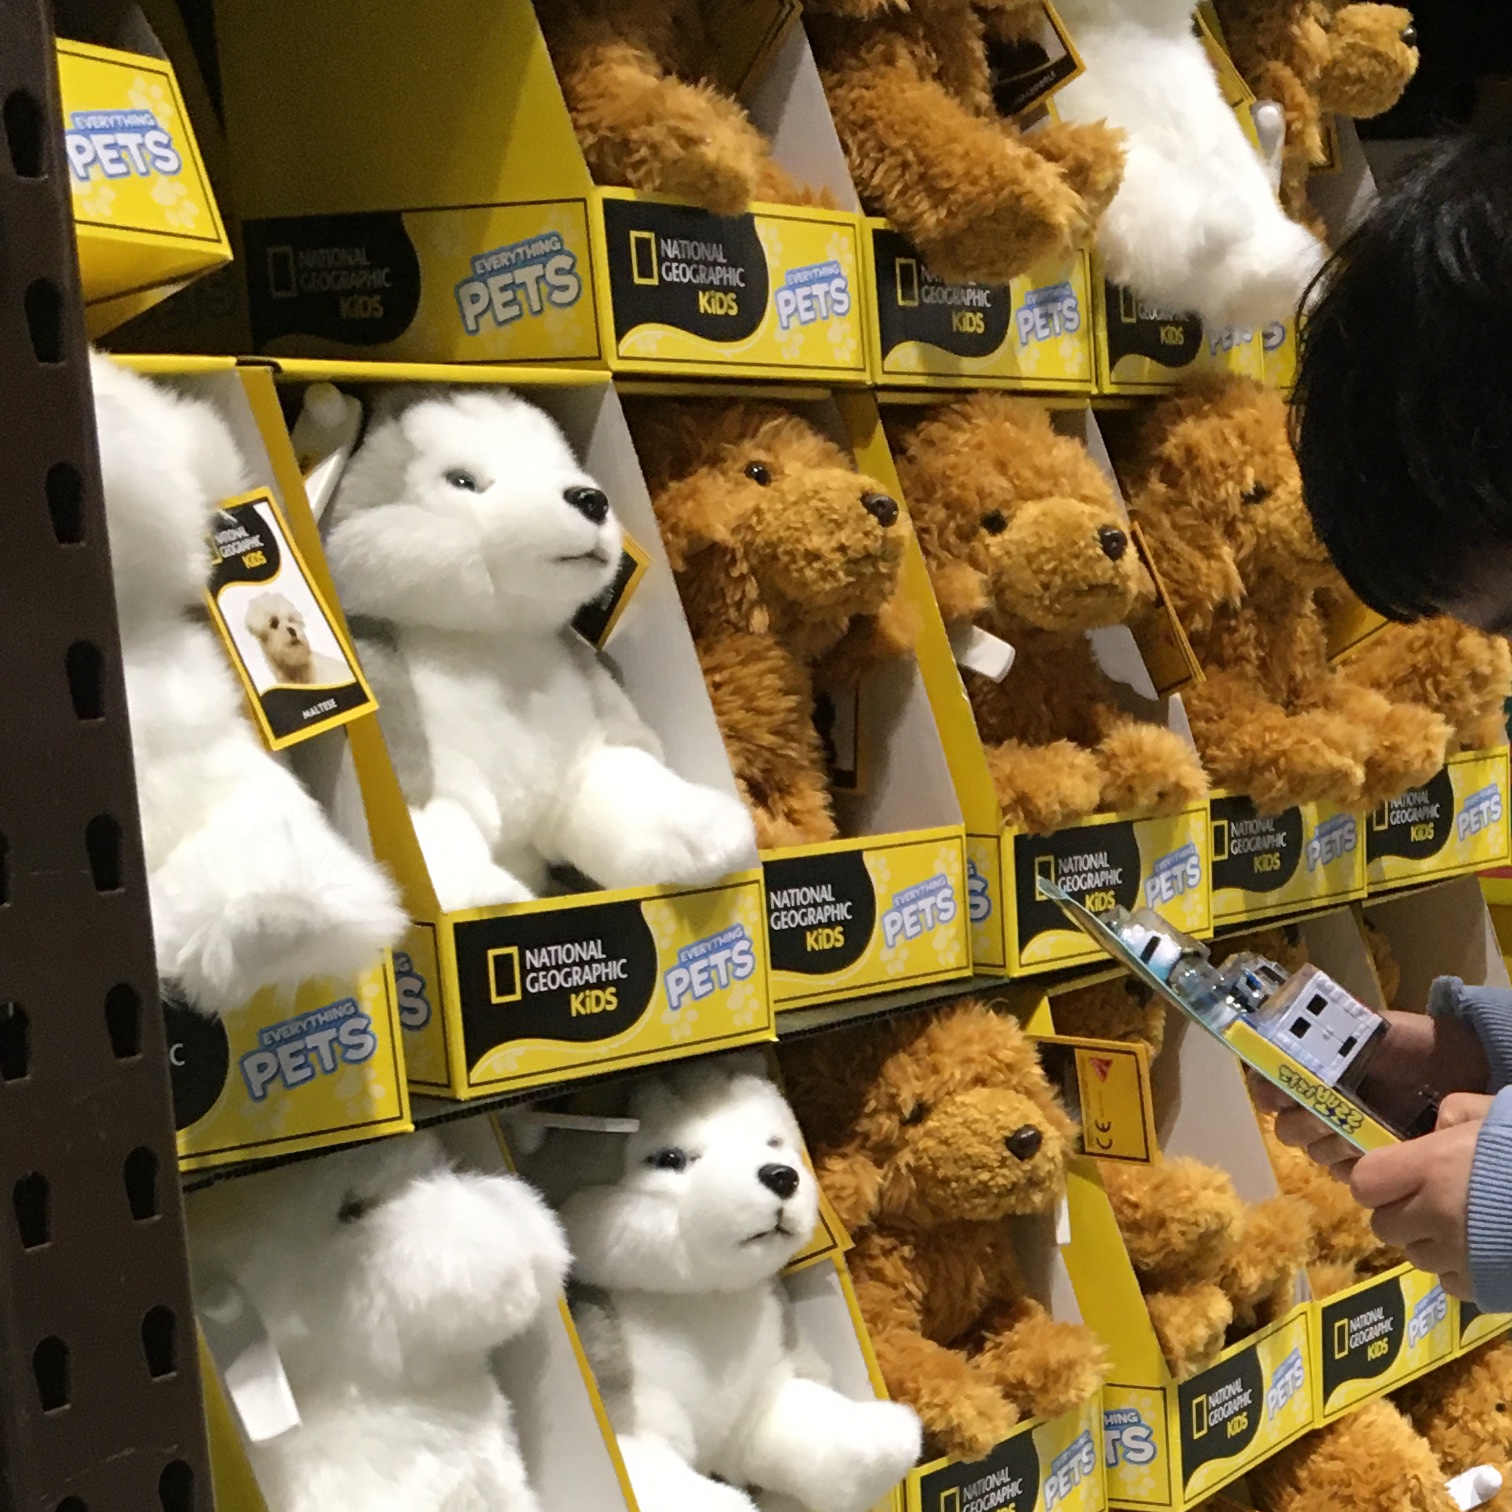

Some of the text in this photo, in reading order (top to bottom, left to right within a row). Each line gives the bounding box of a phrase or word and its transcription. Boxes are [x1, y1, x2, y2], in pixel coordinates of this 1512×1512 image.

[75, 113, 155, 129] EVERYTHING
[66, 130, 179, 178] PETS
[300, 247, 370, 268] NATIONAL
[474, 235, 561, 275] EVERYTHING
[660, 239, 727, 262] NATIONAL
[300, 267, 393, 290] GEOGRAPHIC
[661, 262, 745, 287] GEOGRAPHIC
[459, 254, 580, 332] PETS
[777, 277, 849, 328] PETS
[921, 285, 992, 308] GEOGRAPHIC
[1017, 299, 1080, 345] PETS
[302, 699, 338, 719] MALTESE
[1230, 817, 1275, 838] NATIONAL
[1390, 804, 1441, 825] GEOGRAPHIC
[1457, 793, 1503, 840] PETS
[1230, 832, 1287, 855] GEOGRAPHIC
[1307, 823, 1358, 873] PETS
[1058, 851, 1110, 875] NATIONAL
[894, 876, 948, 906] EVERYTHING
[1058, 868, 1123, 892] GEOGRAPHIC
[1145, 855, 1201, 908] PETS
[770, 884, 835, 910] NATIONAL
[770, 902, 852, 930] GEOGRAPHIC
[882, 888, 955, 947] PETS
[525, 939, 606, 970] NATIONAL
[680, 927, 744, 962] EVERYTHING
[525, 959, 628, 994] GEOGRAPHIC
[665, 940, 755, 1008] PETS
[262, 1002, 356, 1046] EVERYTHING
[243, 1017, 375, 1098] PETS
[1350, 1306, 1385, 1331] NATIONAL
[1350, 1317, 1394, 1349] GEOGRAPHIC
[1408, 1292, 1447, 1348] PETS
[1208, 1378, 1243, 1408] NATIONAL
[1266, 1359, 1305, 1420] PETS
[1208, 1389, 1252, 1427] GEOGRAPHIC
[963, 1467, 1011, 1502] NATIONAL
[1044, 1441, 1096, 1512] PETS
